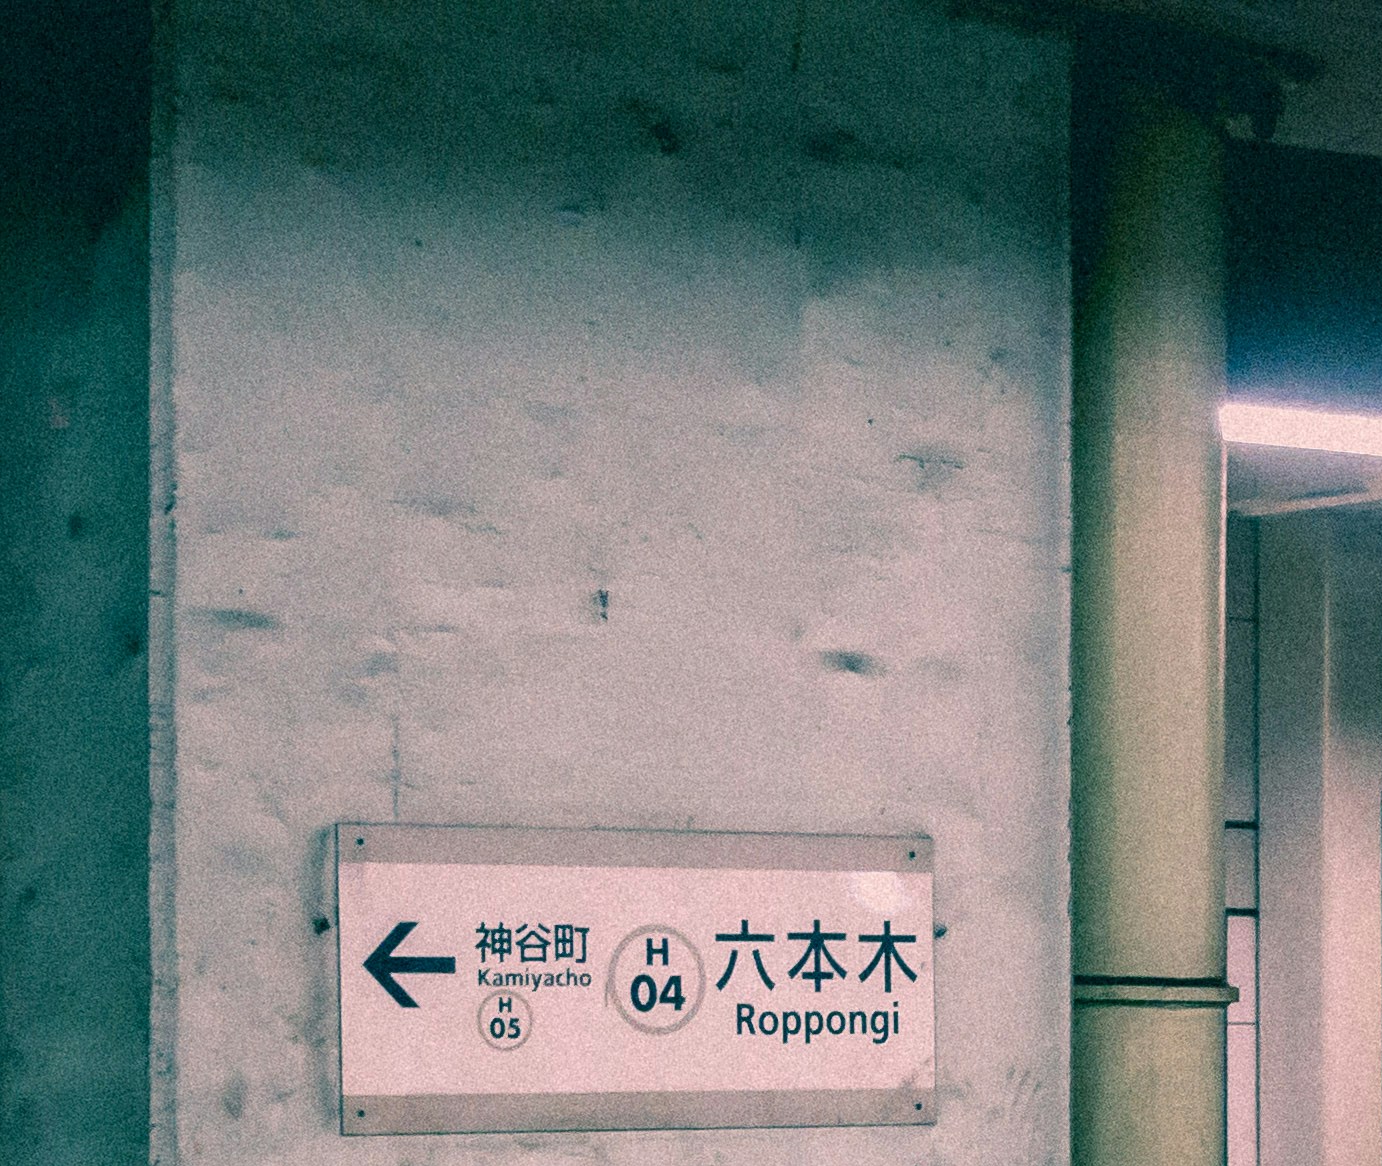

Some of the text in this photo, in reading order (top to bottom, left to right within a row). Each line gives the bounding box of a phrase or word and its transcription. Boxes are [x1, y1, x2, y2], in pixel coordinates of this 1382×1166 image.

[475, 921, 590, 963] 神谷町
[645, 937, 670, 966] H
[714, 918, 918, 993] 六本木
[477, 967, 592, 992] Kamiyacho
[630, 973, 686, 1013] 04
[498, 996, 512, 1013] H
[489, 1017, 521, 1039] 05
[736, 1001, 899, 1044] Roppongi
